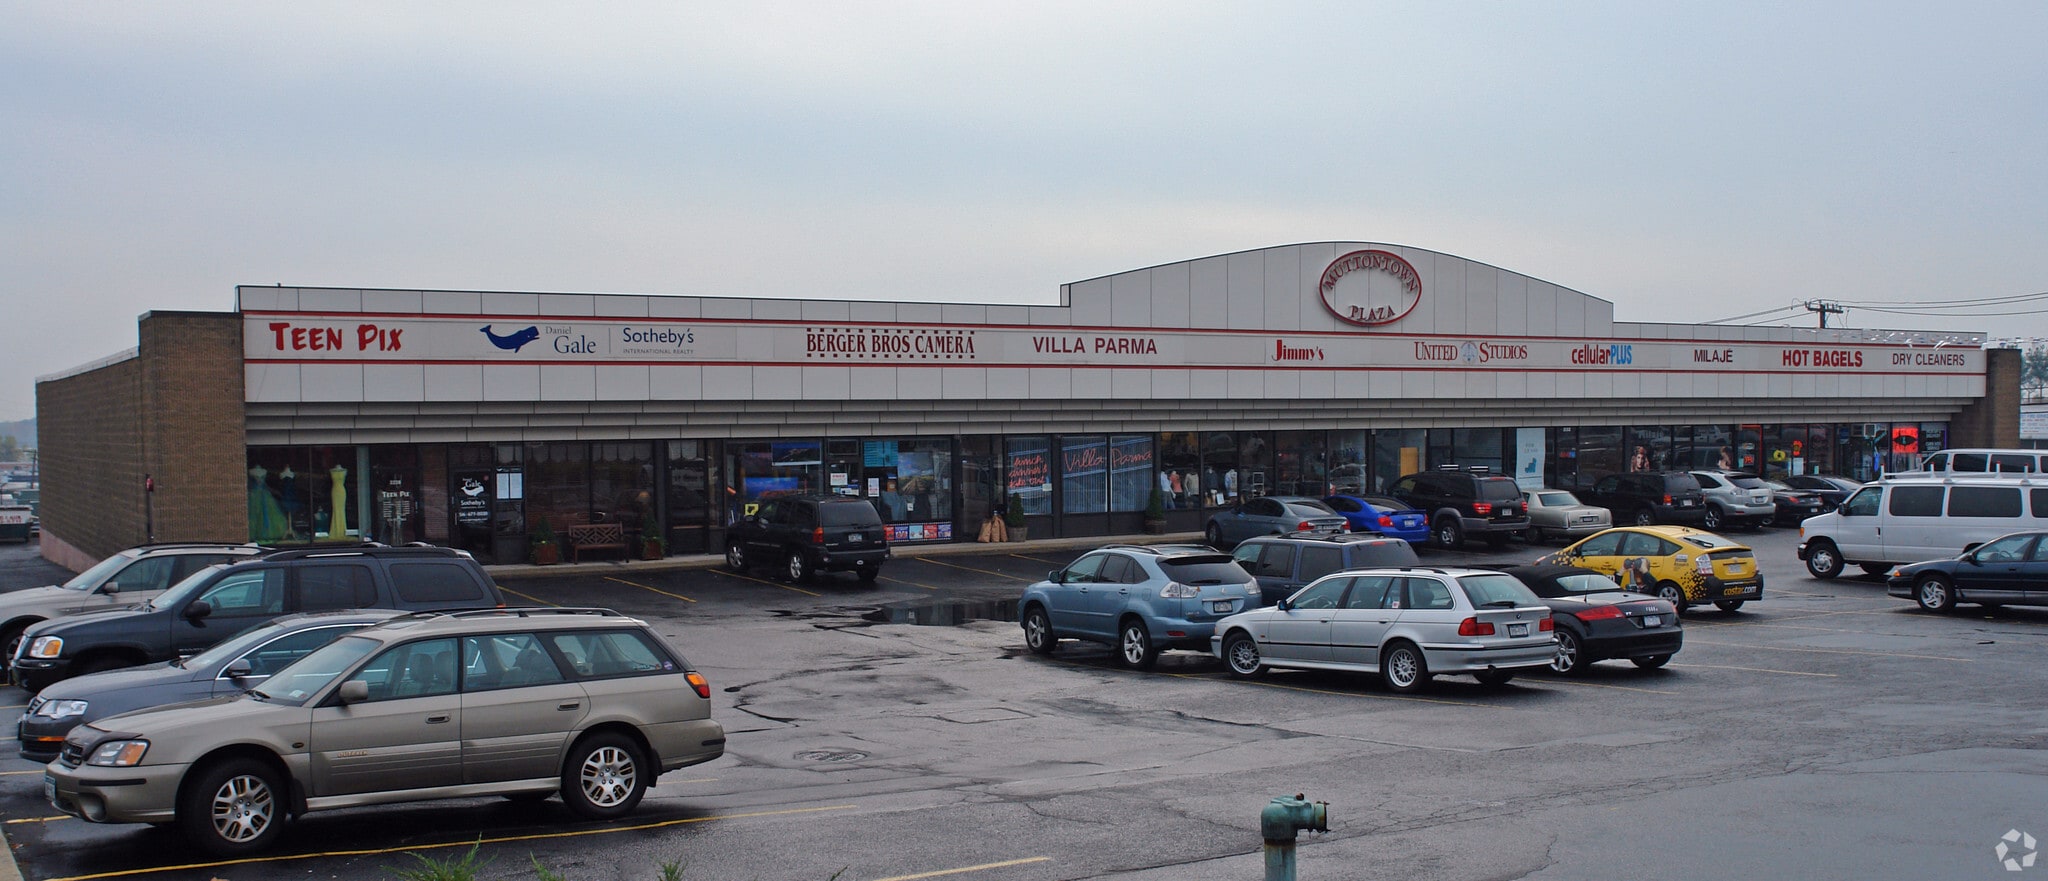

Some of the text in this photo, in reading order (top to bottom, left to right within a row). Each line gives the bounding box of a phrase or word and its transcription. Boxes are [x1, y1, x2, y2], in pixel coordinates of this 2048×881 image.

[1323, 254, 1418, 292] MUTTONTOWN
[1350, 305, 1396, 321] PLAZA
[545, 326, 572, 335] Daniel
[623, 327, 695, 347] Sotheby's
[554, 335, 597, 354] Gale
[807, 334, 975, 354] BERGER BROS CAMERA
[1032, 336, 1158, 355] VILLA PARMA
[1271, 339, 1324, 361] Jimmy's
[1782, 350, 1863, 368] HOT BAGELS
[1892, 353, 1965, 366] DRY CLEANERS
[1064, 448, 1153, 472] Villa Parma
[1723, 586, 1757, 597] costar.com
